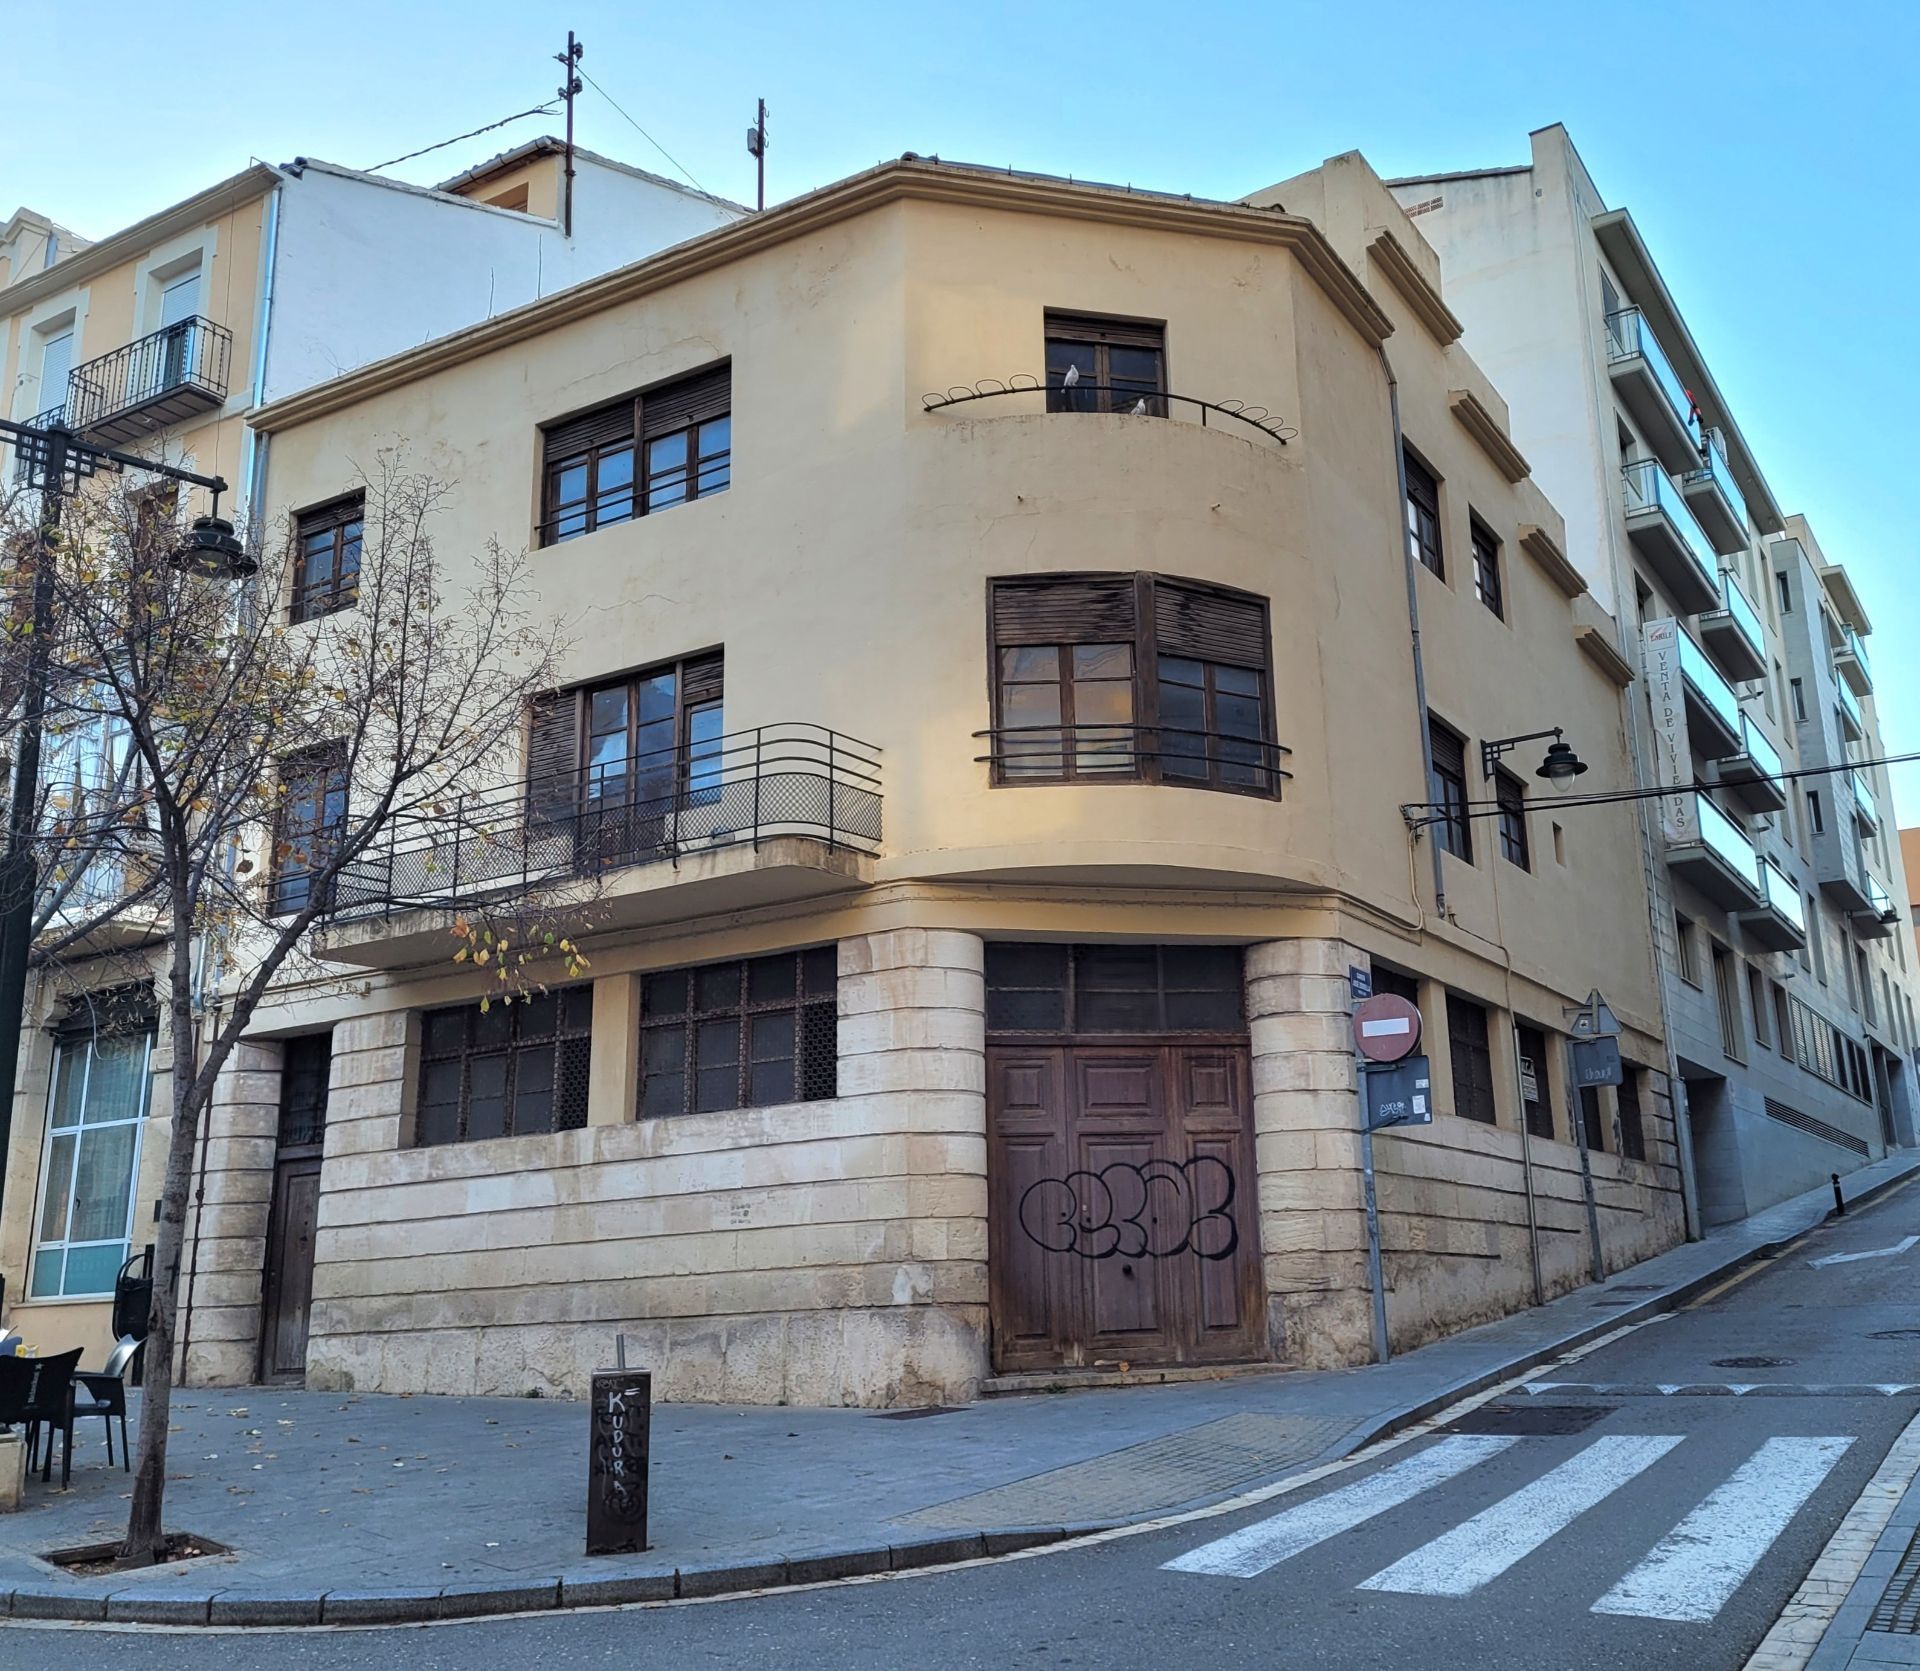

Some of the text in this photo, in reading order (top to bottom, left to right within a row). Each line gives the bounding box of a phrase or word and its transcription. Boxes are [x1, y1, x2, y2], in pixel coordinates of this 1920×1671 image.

[1658, 651, 1685, 828] VENTA DE VIVIEDAS
